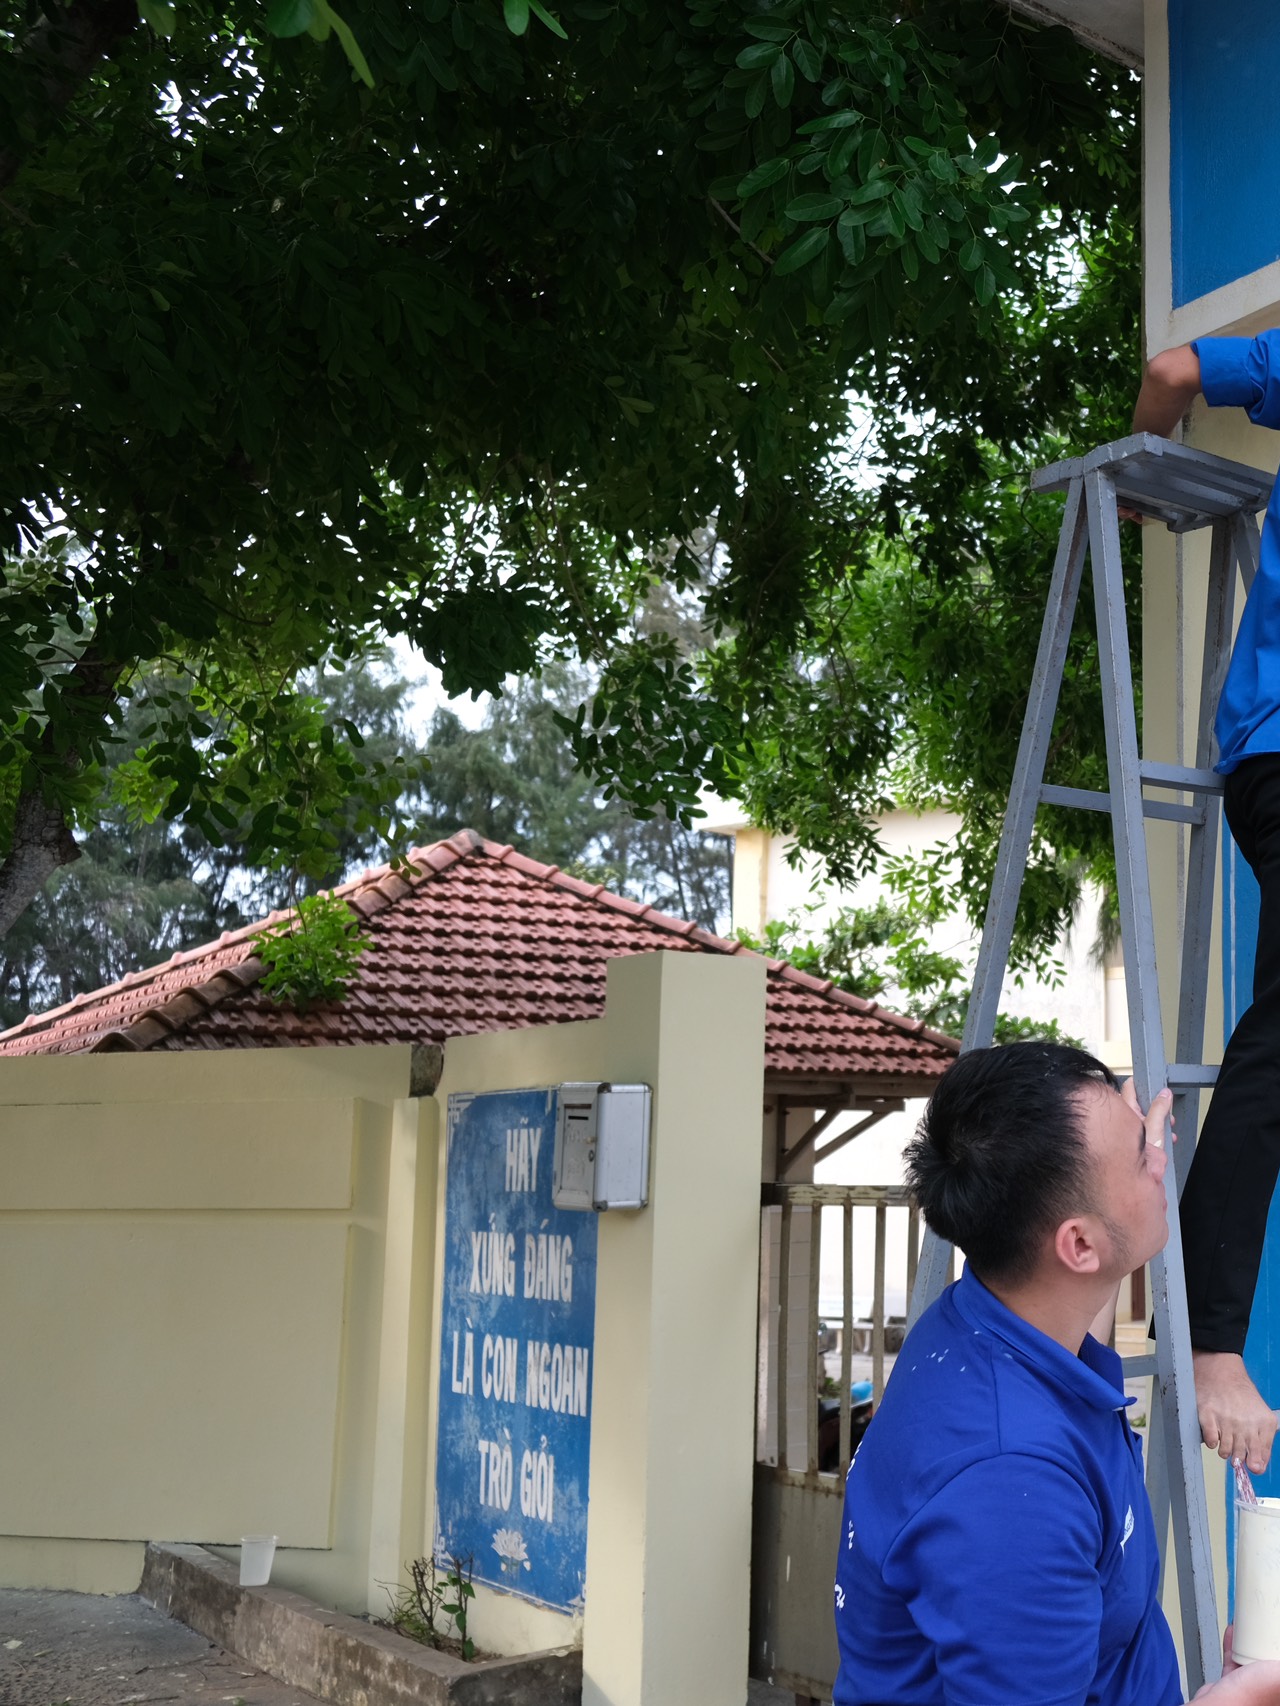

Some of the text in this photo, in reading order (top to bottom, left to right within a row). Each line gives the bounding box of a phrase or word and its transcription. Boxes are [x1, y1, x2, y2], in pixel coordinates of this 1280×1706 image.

[505, 1117, 542, 1192] HÃY
[469, 1212, 573, 1303] XỨNG ĐÁNG
[451, 1317, 589, 1418] LÀ CON NGOAN
[478, 1427, 554, 1523] TRÒ GIỎI
